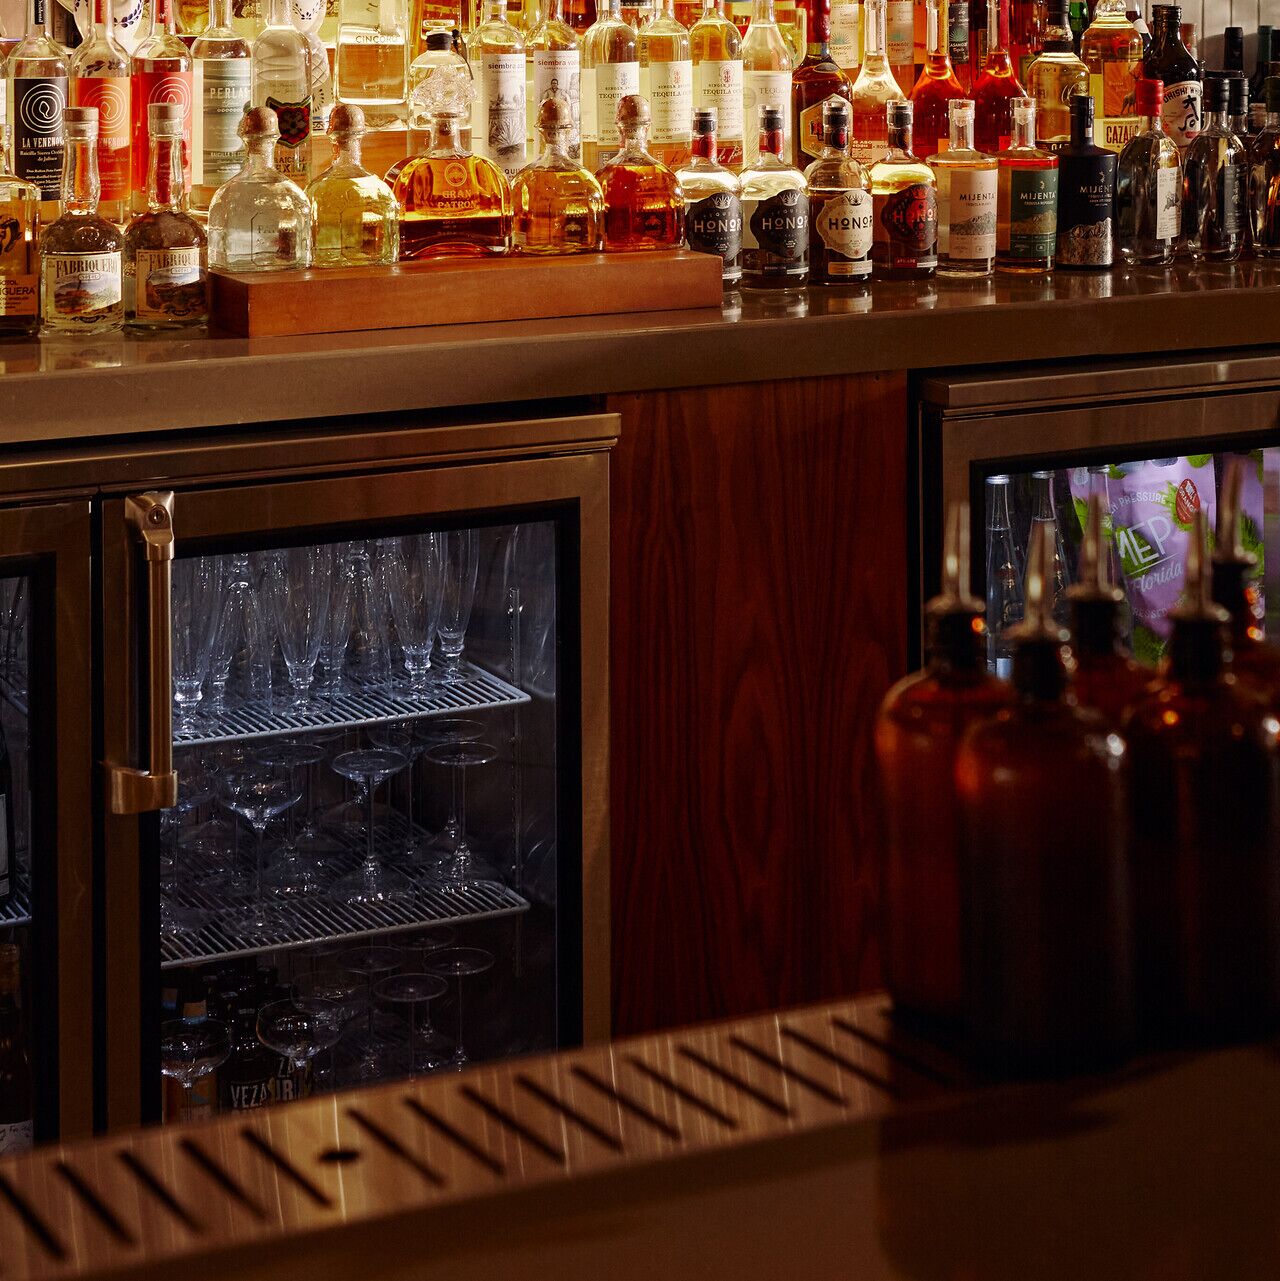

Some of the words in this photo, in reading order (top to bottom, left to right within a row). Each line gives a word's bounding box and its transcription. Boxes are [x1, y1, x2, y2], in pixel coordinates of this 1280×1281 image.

[487, 61, 515, 71] siembra
[537, 58, 567, 67] siembra
[652, 90, 681, 98] TEQUILA
[22, 137, 31, 148] LA
[959, 192, 995, 202] MIJENTA
[1019, 191, 1056, 201] MIJENTA
[230, 1081, 268, 1109] VEZA
